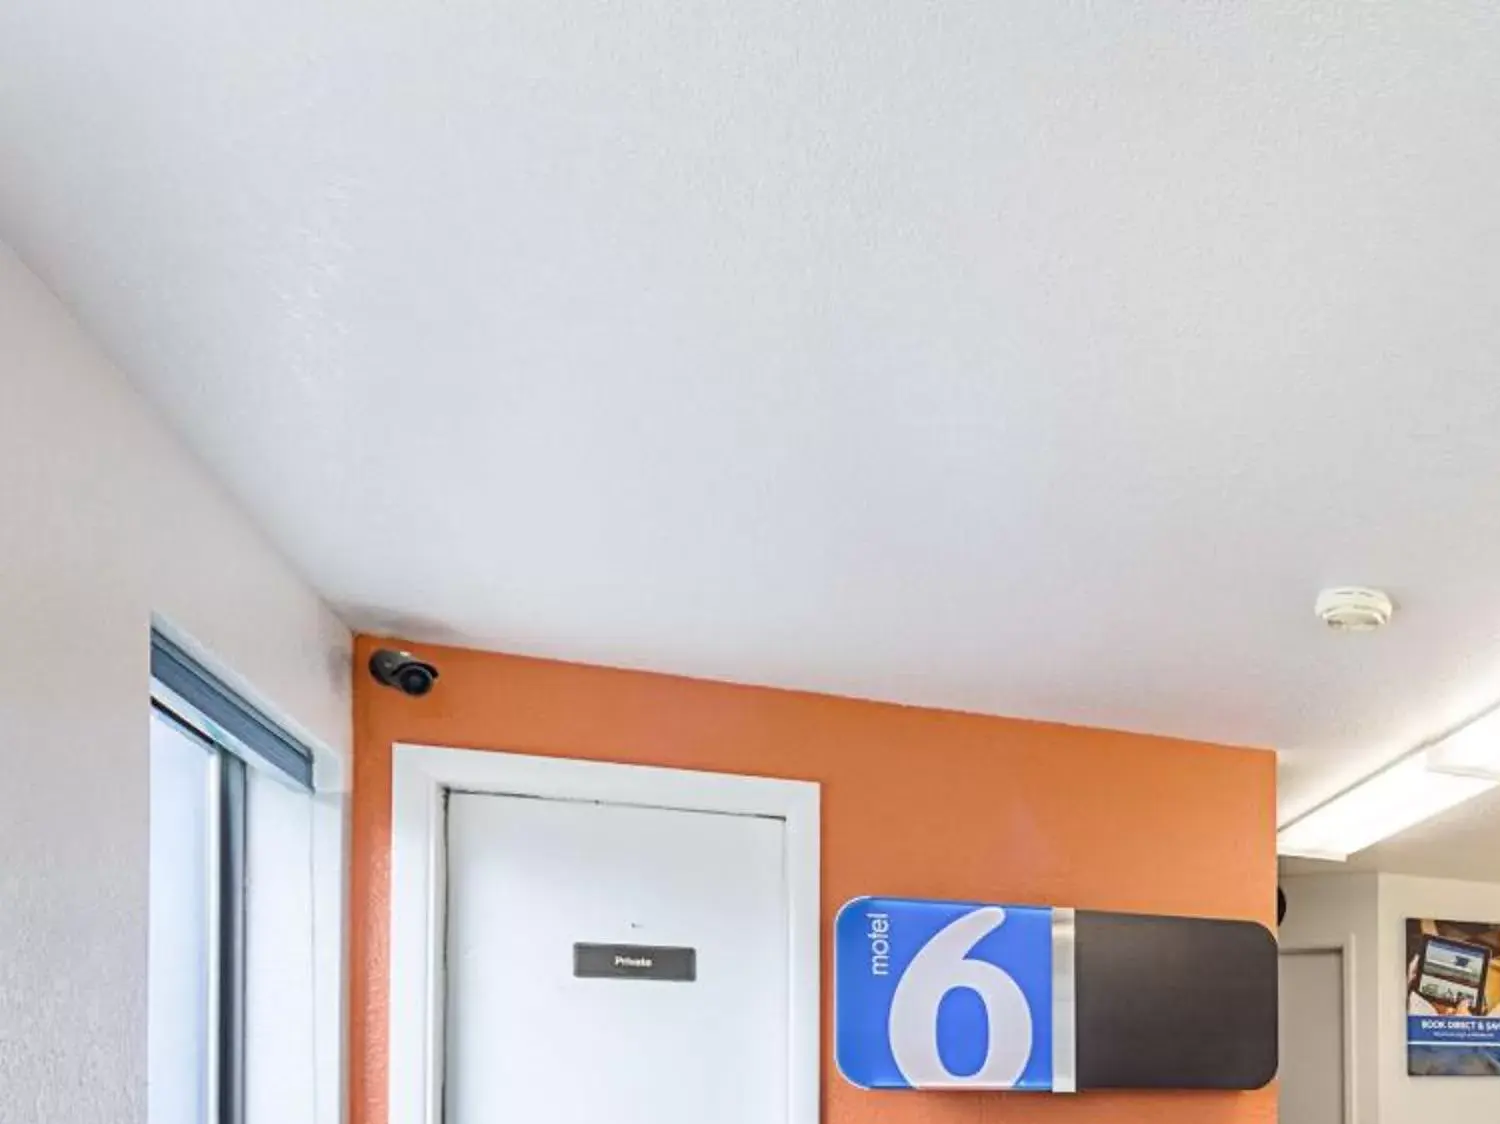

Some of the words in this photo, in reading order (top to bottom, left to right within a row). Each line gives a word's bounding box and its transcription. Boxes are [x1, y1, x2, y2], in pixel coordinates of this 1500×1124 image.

[615, 956, 653, 968] Private
[865, 912, 890, 976] motel
[888, 906, 1033, 1088] 6
[1421, 1020, 1446, 1030] BOOK
[1448, 1021, 1475, 1030] DIRECT
[1478, 1021, 1485, 1031] &
